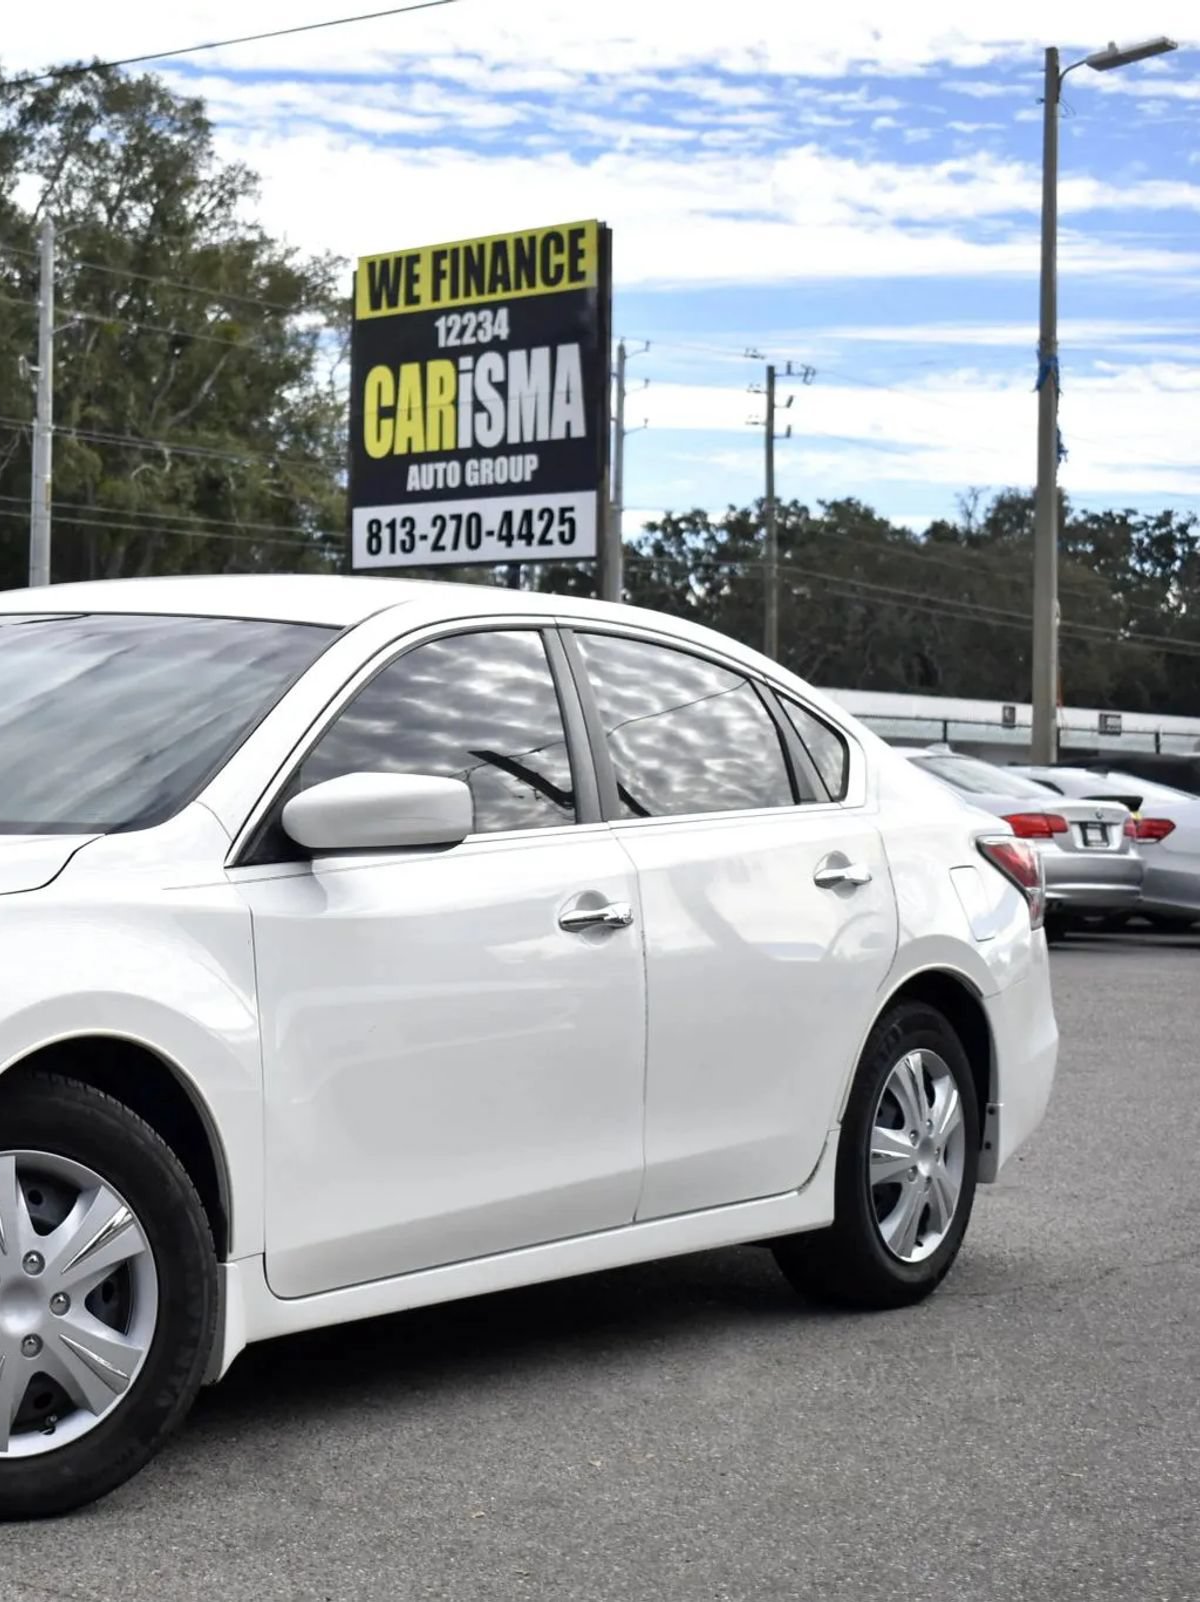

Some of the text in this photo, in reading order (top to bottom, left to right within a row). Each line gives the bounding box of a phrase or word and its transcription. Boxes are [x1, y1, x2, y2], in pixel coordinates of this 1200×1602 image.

[366, 228, 586, 311] WE FINANCE
[434, 307, 509, 348] 12234
[406, 454, 539, 492] AUTO GROUP
[366, 506, 576, 557] 813-270-4425
